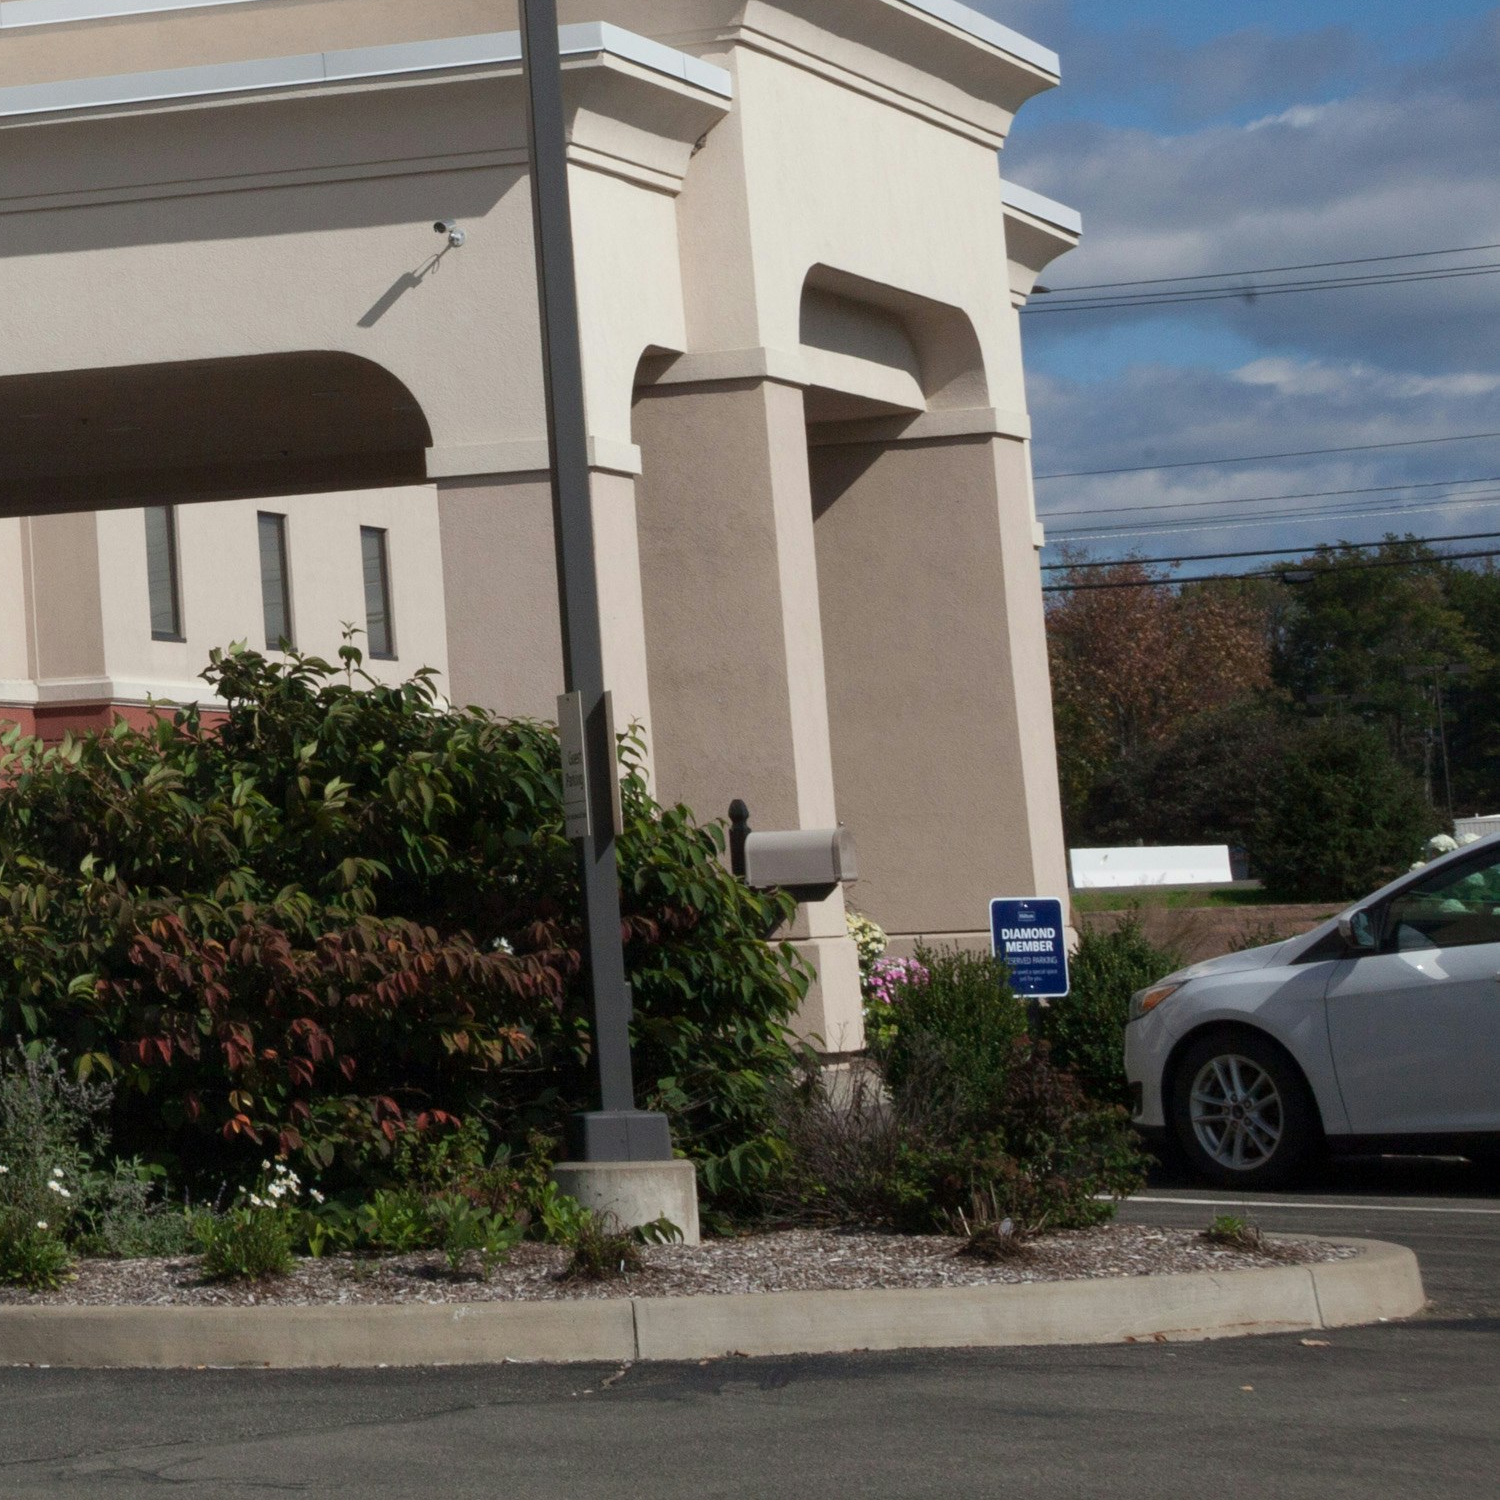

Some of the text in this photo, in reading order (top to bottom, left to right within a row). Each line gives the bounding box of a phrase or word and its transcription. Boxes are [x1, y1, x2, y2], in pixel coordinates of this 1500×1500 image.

[1001, 928, 1055, 940] DIAMOND
[1005, 941, 1054, 953] MEMBER
[1032, 956, 1058, 964] PARKING
